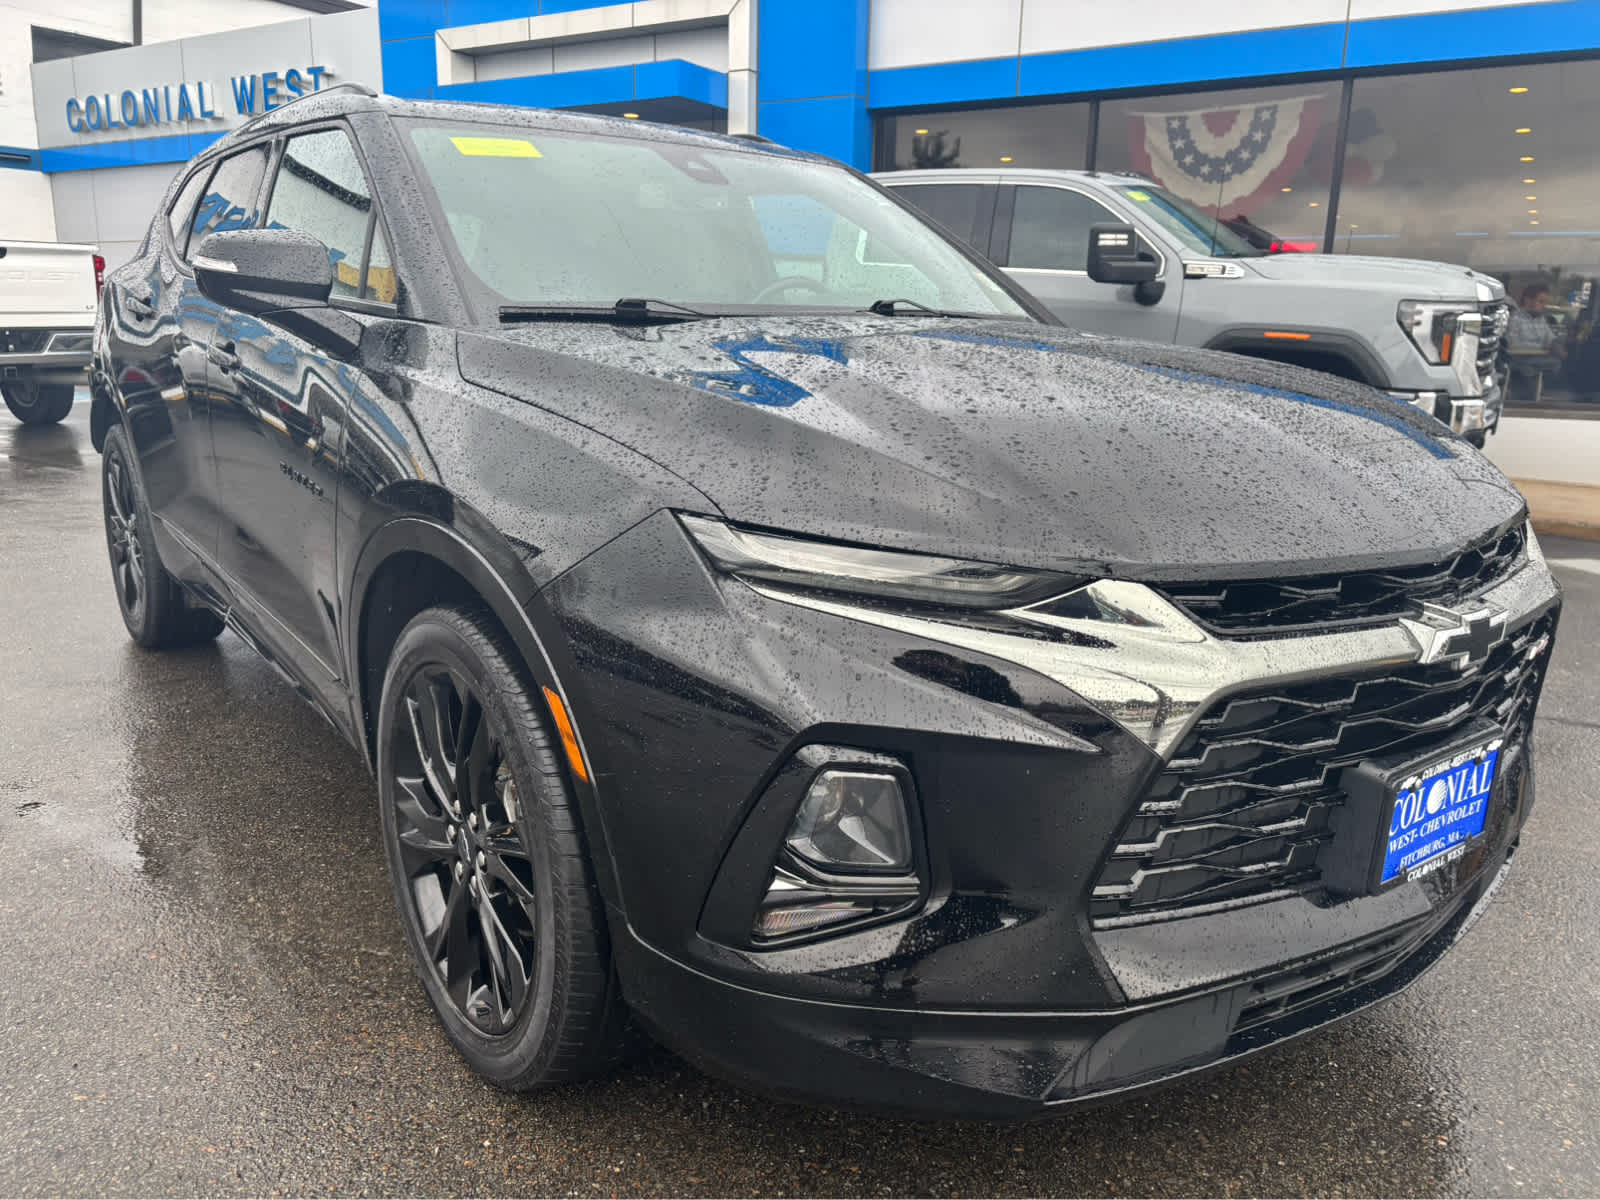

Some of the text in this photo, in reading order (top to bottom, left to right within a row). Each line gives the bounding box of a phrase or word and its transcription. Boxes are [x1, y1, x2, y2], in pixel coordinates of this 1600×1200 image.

[66, 66, 325, 133] COLONIAL WEST
[1388, 759, 1492, 837] COLONIAL
[1419, 798, 1484, 837] CHEVROLET
[1407, 845, 1466, 882] COLONIAL WEST
